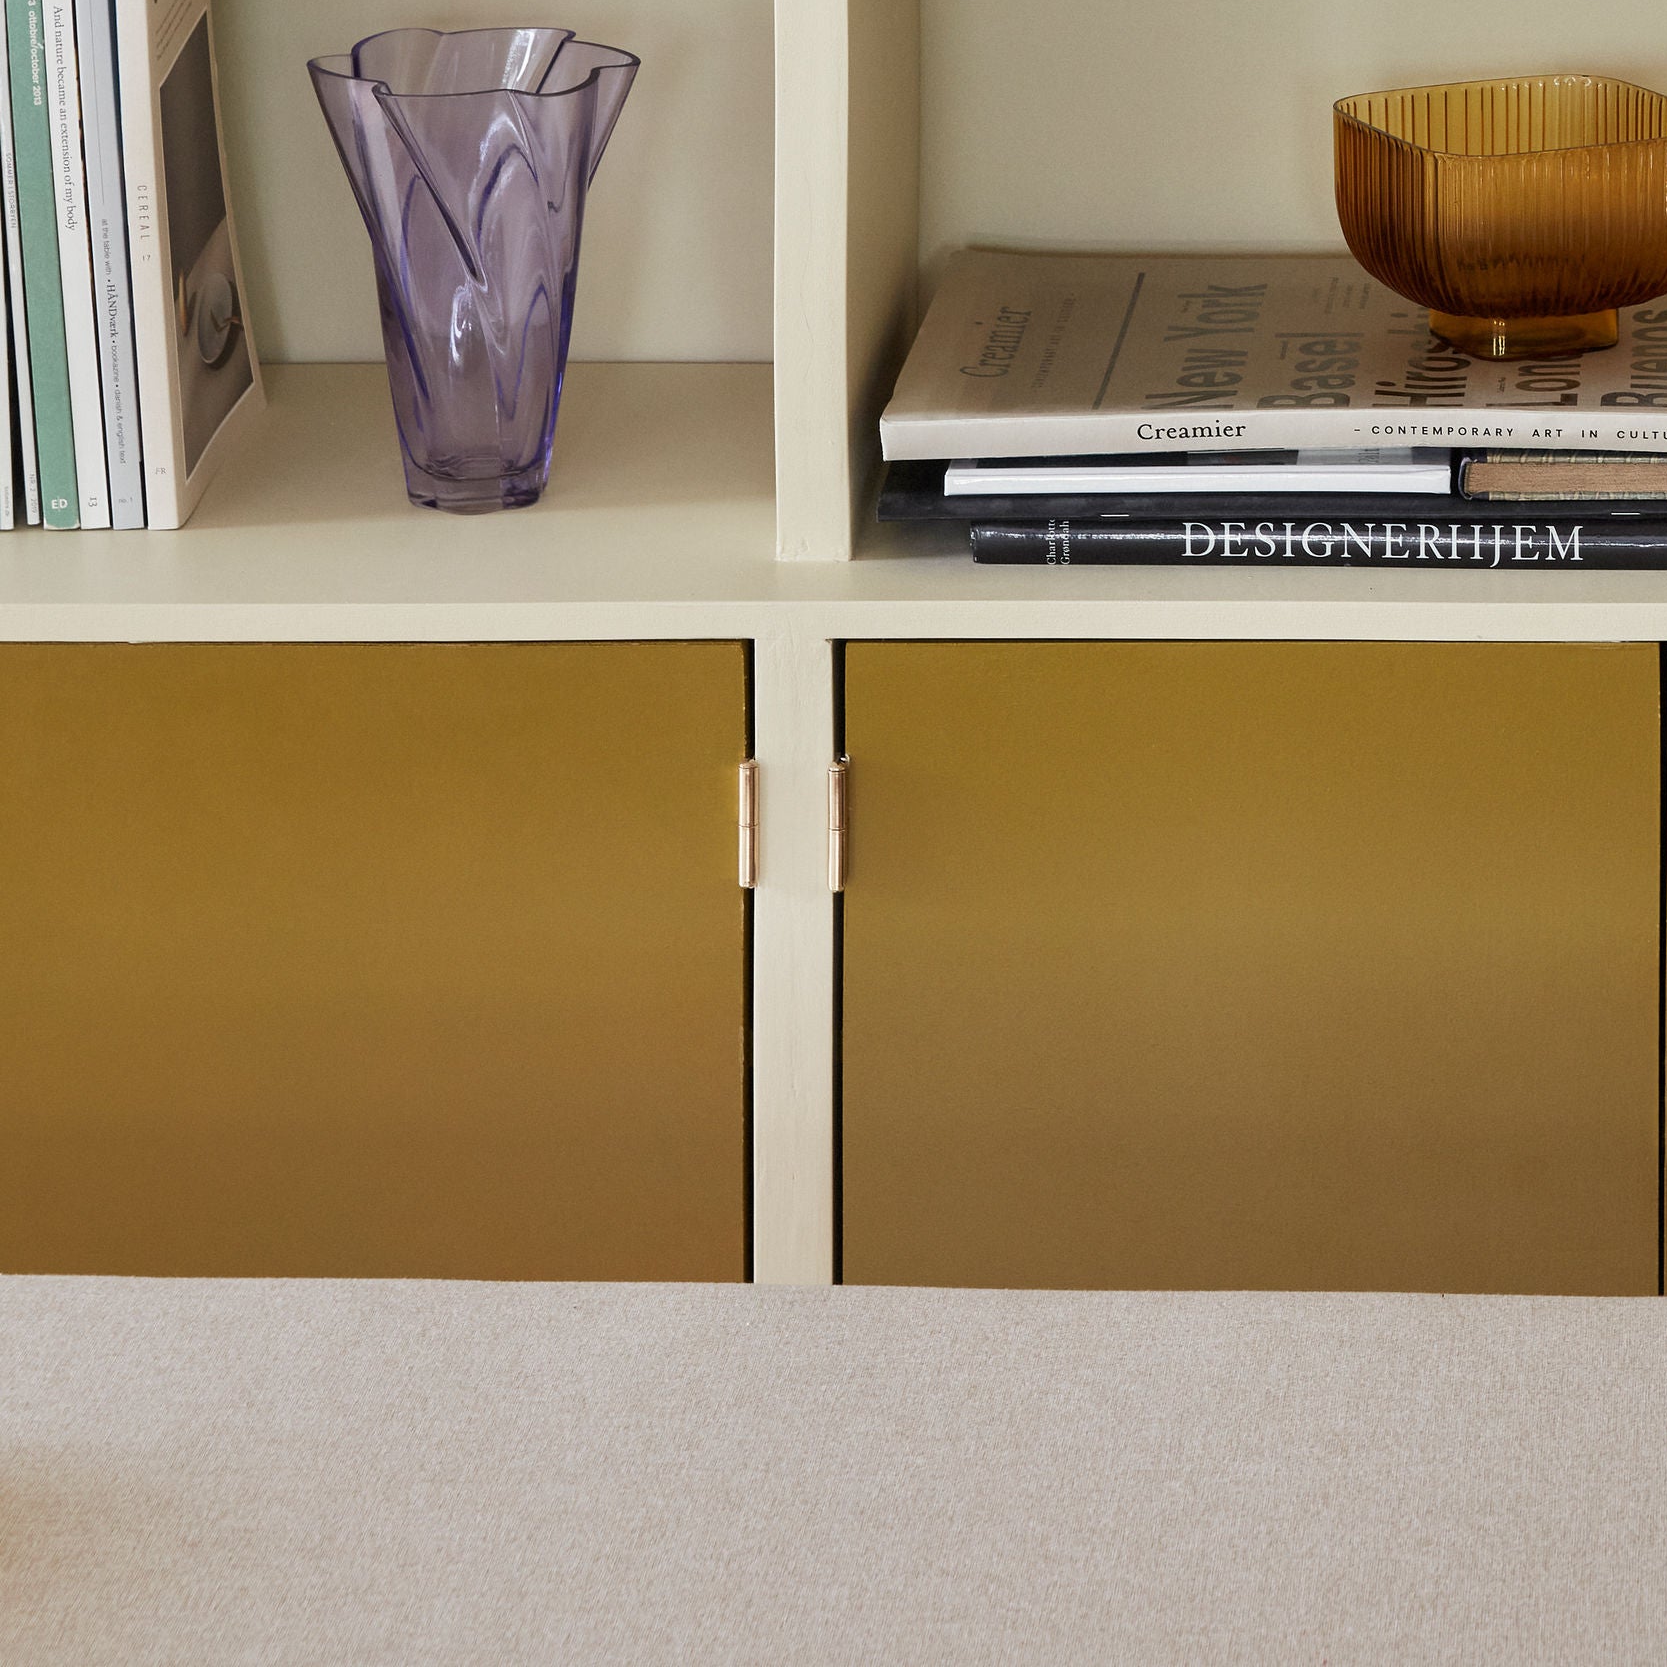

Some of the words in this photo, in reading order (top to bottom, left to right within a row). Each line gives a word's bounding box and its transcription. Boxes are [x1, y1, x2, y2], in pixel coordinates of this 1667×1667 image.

[137, 184, 151, 241] CEREAL
[959, 305, 1033, 379] Creamier
[1163, 282, 1268, 343] York
[1142, 347, 1248, 410] New
[1257, 331, 1365, 408] Basel
[1137, 419, 1247, 441] Creamier
[1371, 425, 1515, 437] CONTEMPORARY
[1531, 428, 1564, 438] ART
[1581, 429, 1599, 438] IN
[1182, 522, 1585, 568] DESIGNERHJEM
